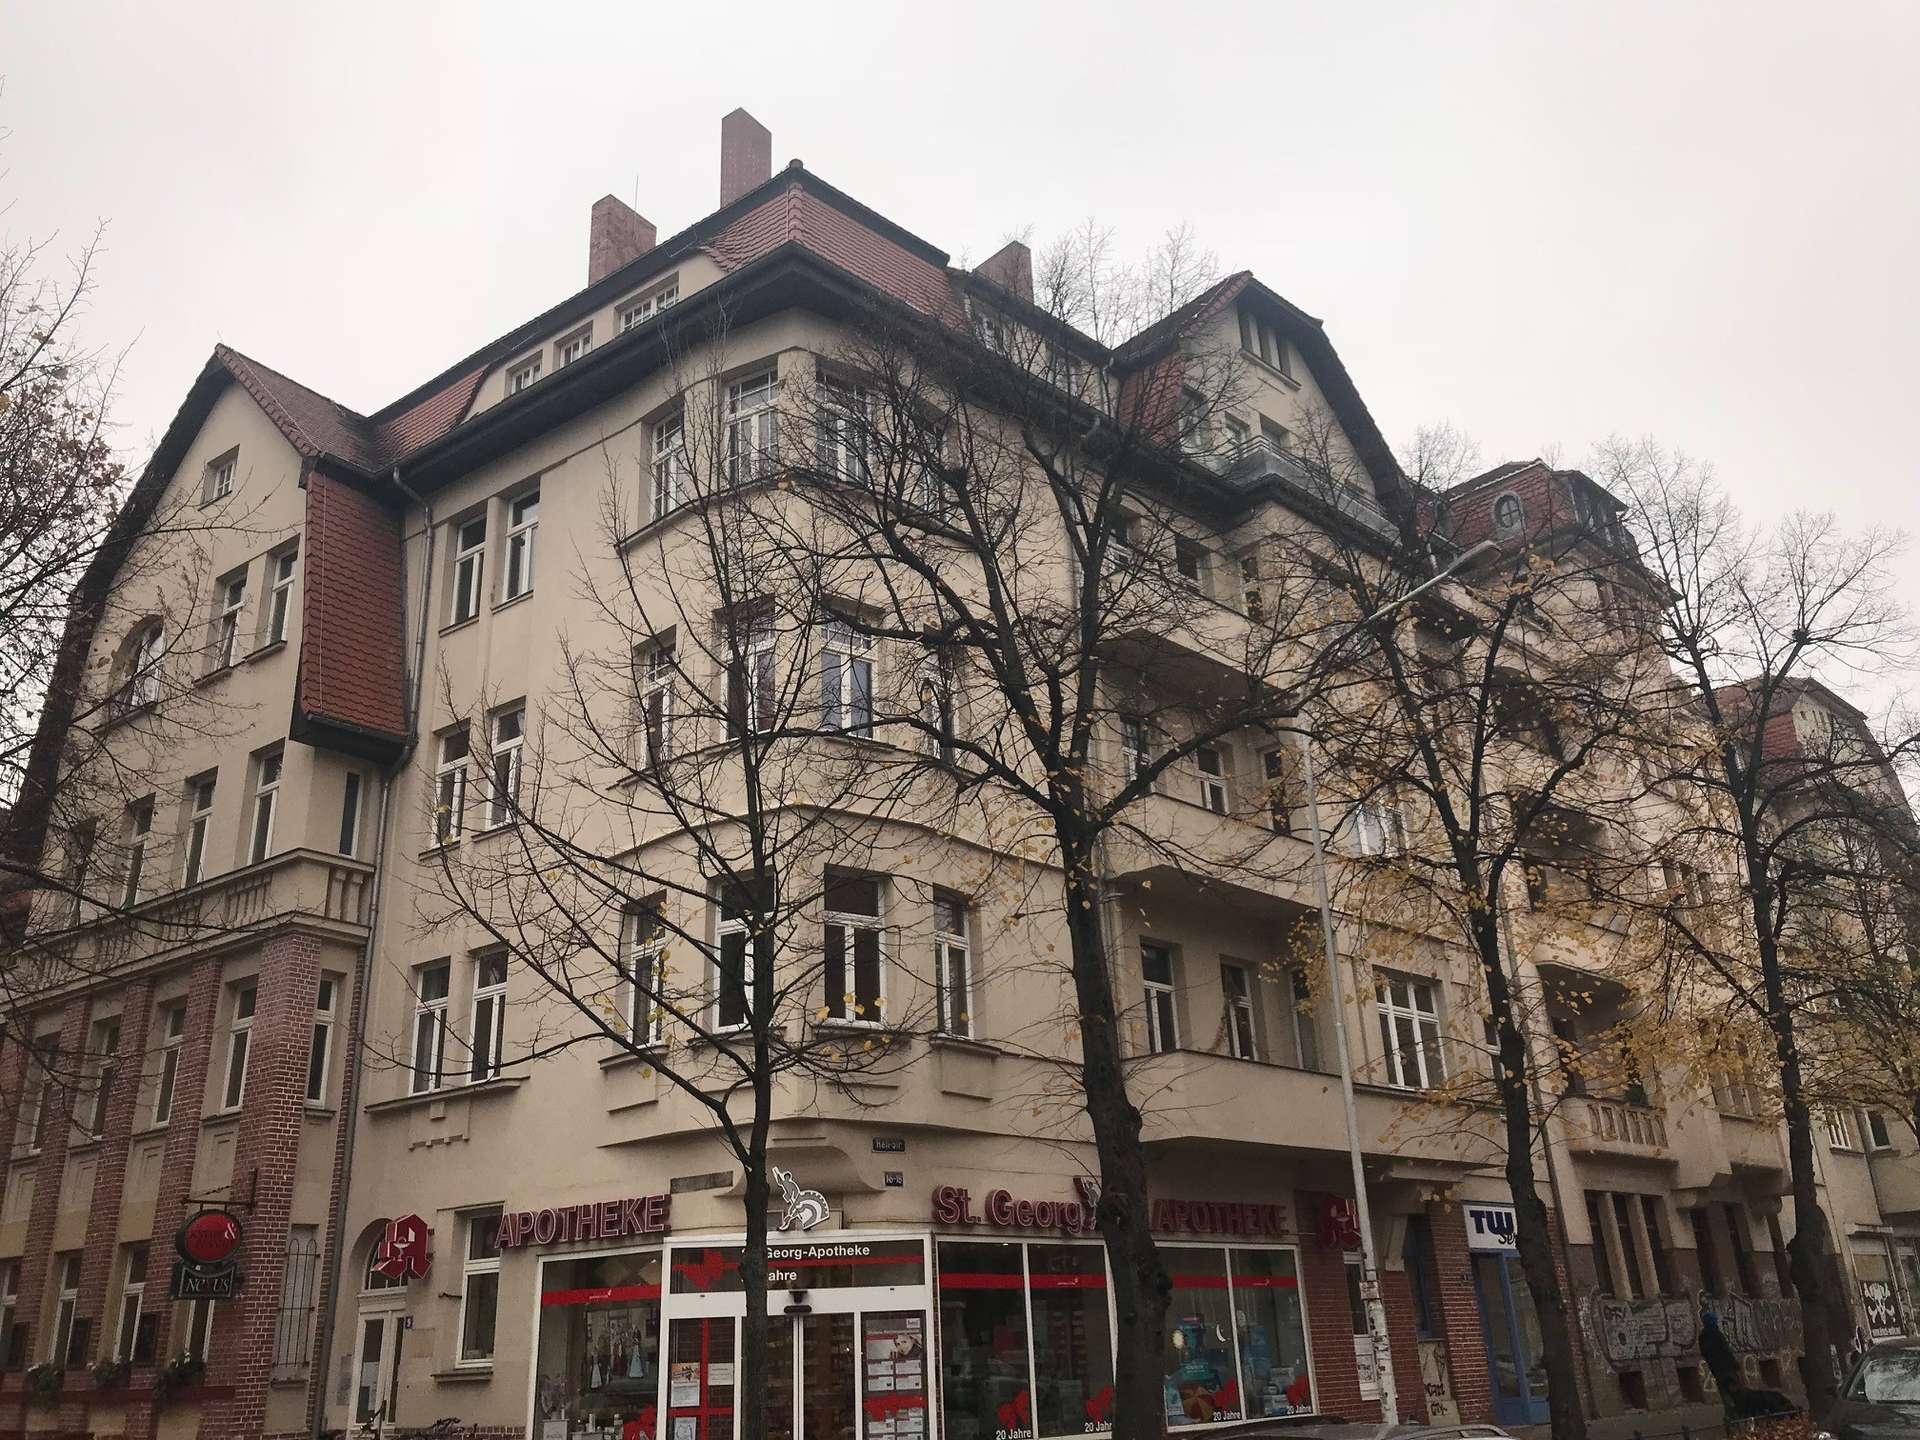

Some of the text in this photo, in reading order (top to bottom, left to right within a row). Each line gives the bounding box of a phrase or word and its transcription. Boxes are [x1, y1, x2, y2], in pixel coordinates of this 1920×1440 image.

[934, 1184, 1083, 1234] St. Georg
[495, 1194, 667, 1248] APOTHEKE
[1151, 1199, 1290, 1235] APOTHEKE
[767, 1244, 871, 1260] Georg-Apotheke
[766, 1269, 798, 1282] ahre
[1212, 1409, 1241, 1421] 20 Jahre
[1286, 1403, 1312, 1415] 20 Jahre
[1084, 1420, 1113, 1433] 20 Jahr
[996, 1428, 1032, 1440] 20 Jahre
